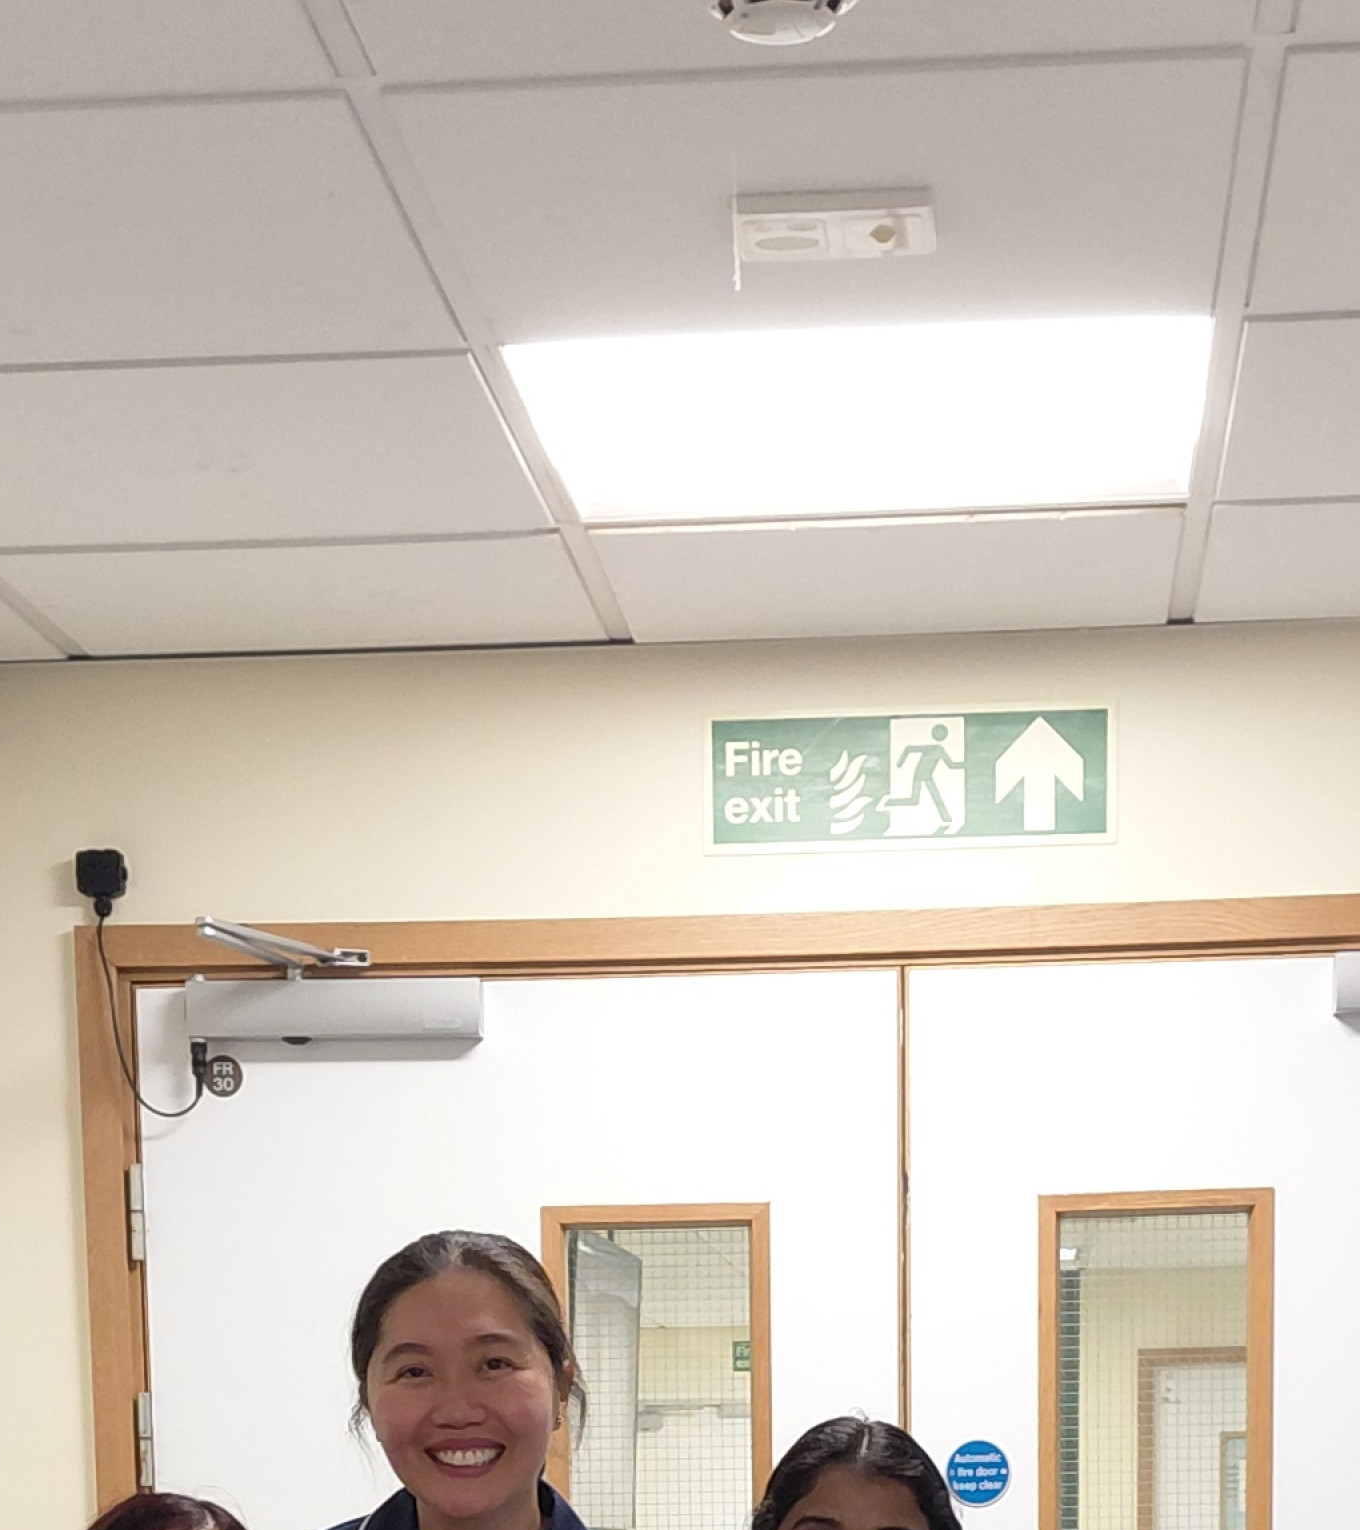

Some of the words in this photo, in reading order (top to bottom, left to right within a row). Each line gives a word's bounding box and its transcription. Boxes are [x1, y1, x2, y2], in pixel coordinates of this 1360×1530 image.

[724, 741, 803, 778] Fire
[724, 787, 801, 824] exit
[213, 1061, 235, 1076] FR
[212, 1077, 235, 1092] 30
